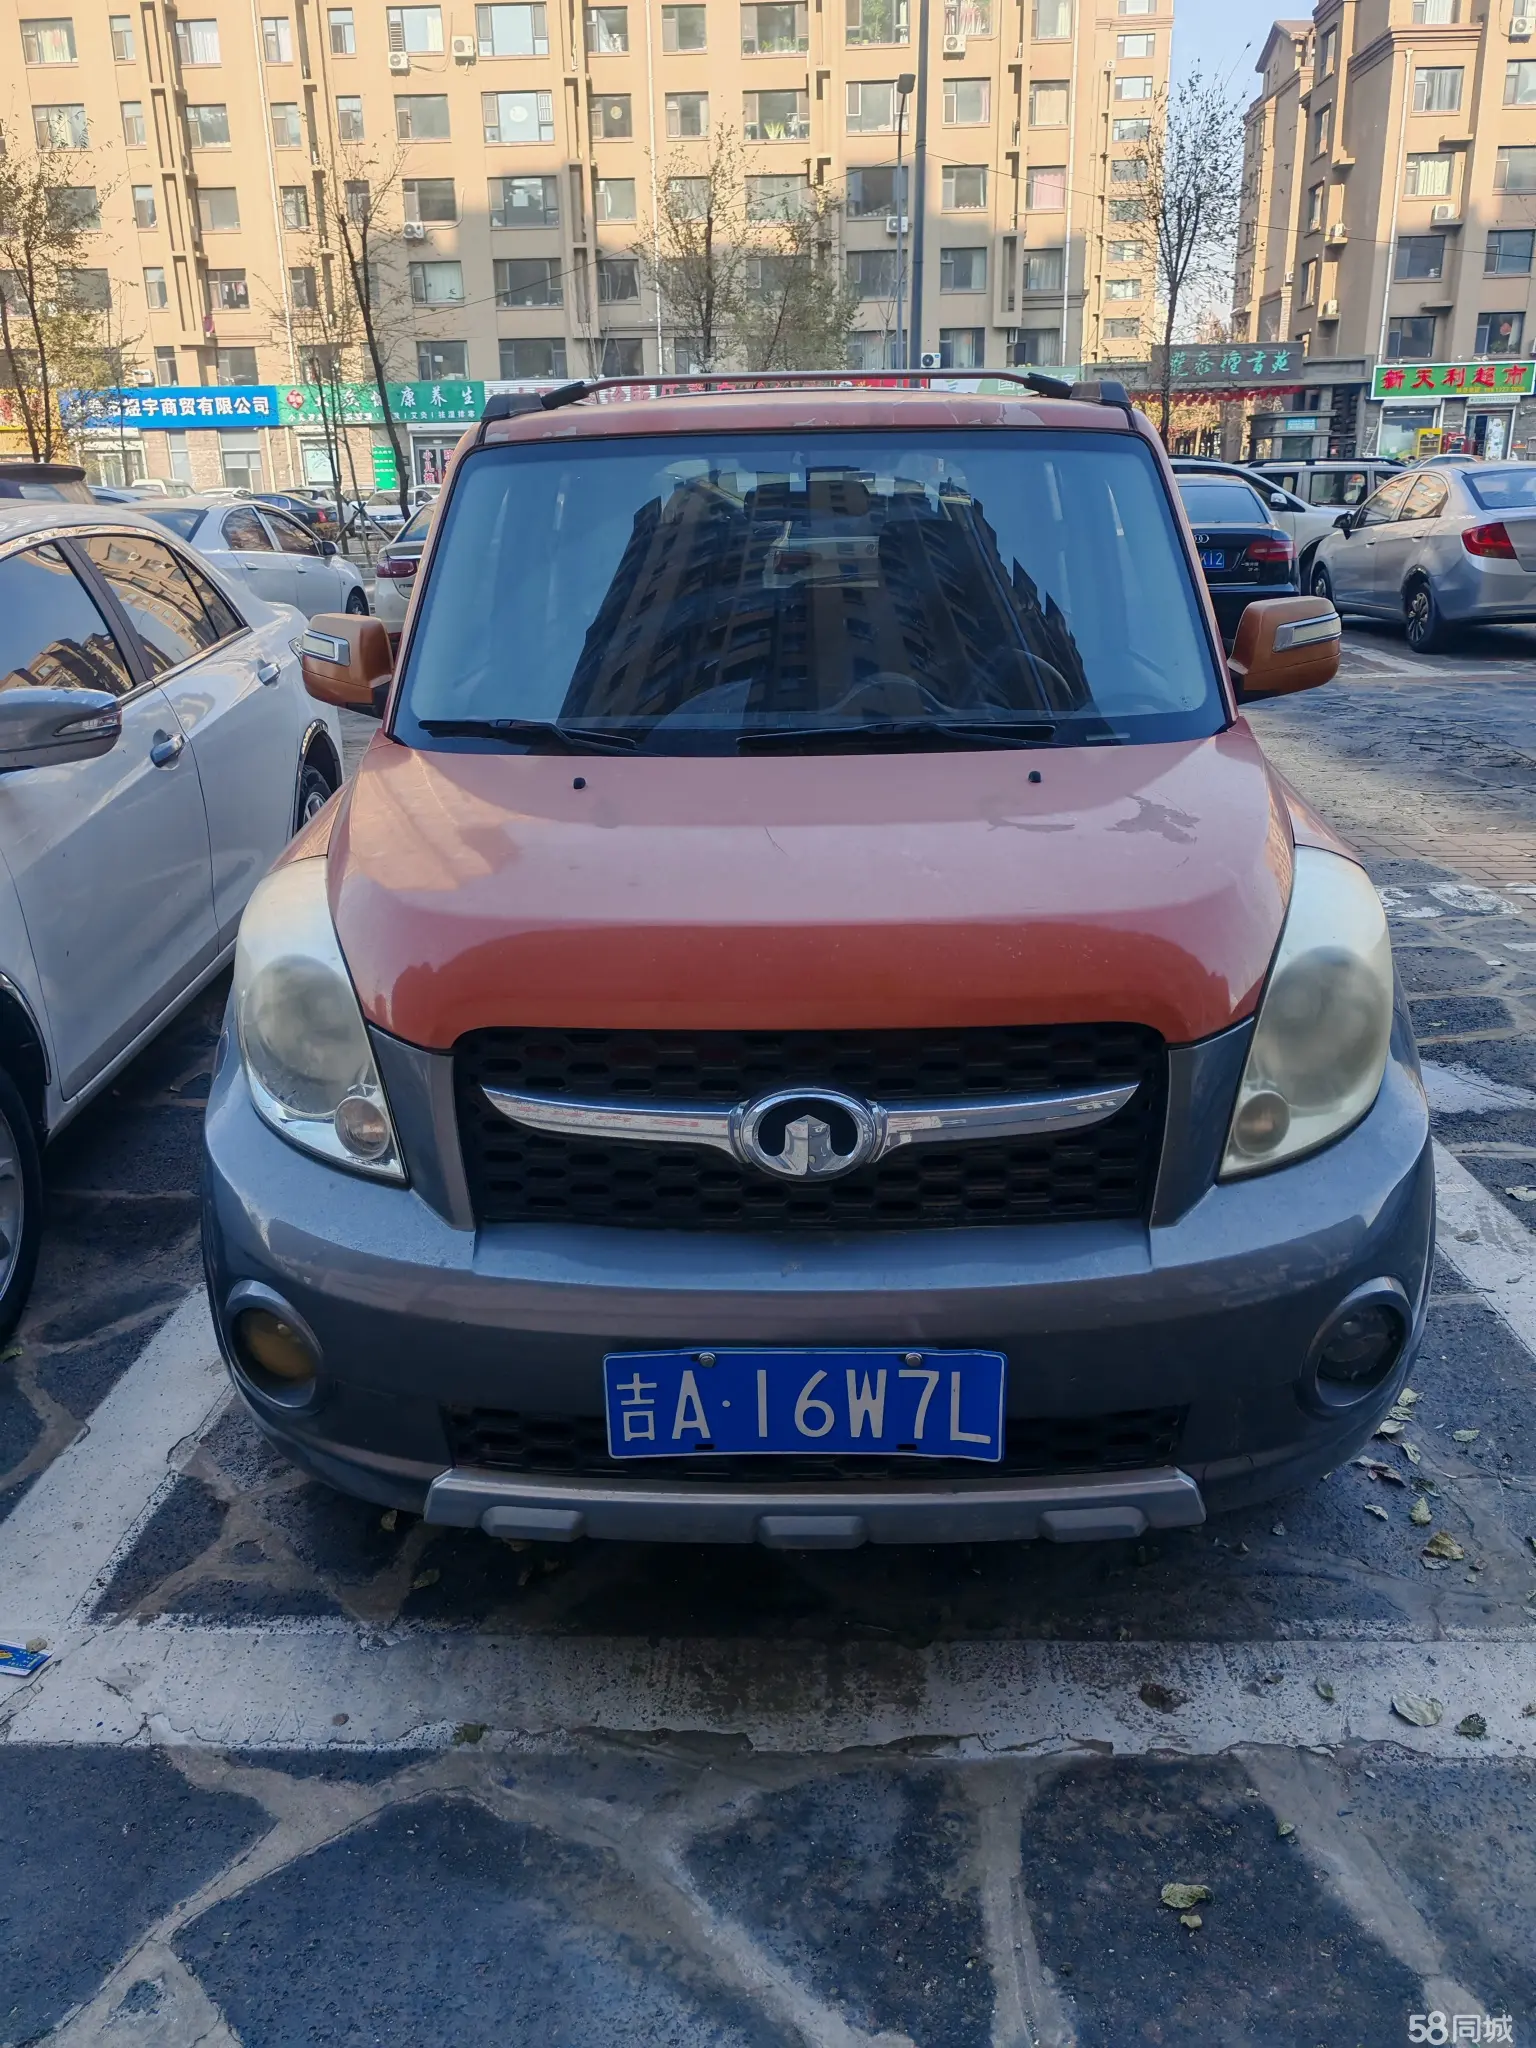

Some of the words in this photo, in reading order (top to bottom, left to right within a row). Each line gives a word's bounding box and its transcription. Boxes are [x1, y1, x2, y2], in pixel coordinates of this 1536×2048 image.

[1383, 364, 1527, 389] 新天利超市
[616, 1369, 992, 1444] 吉A·16W7L
